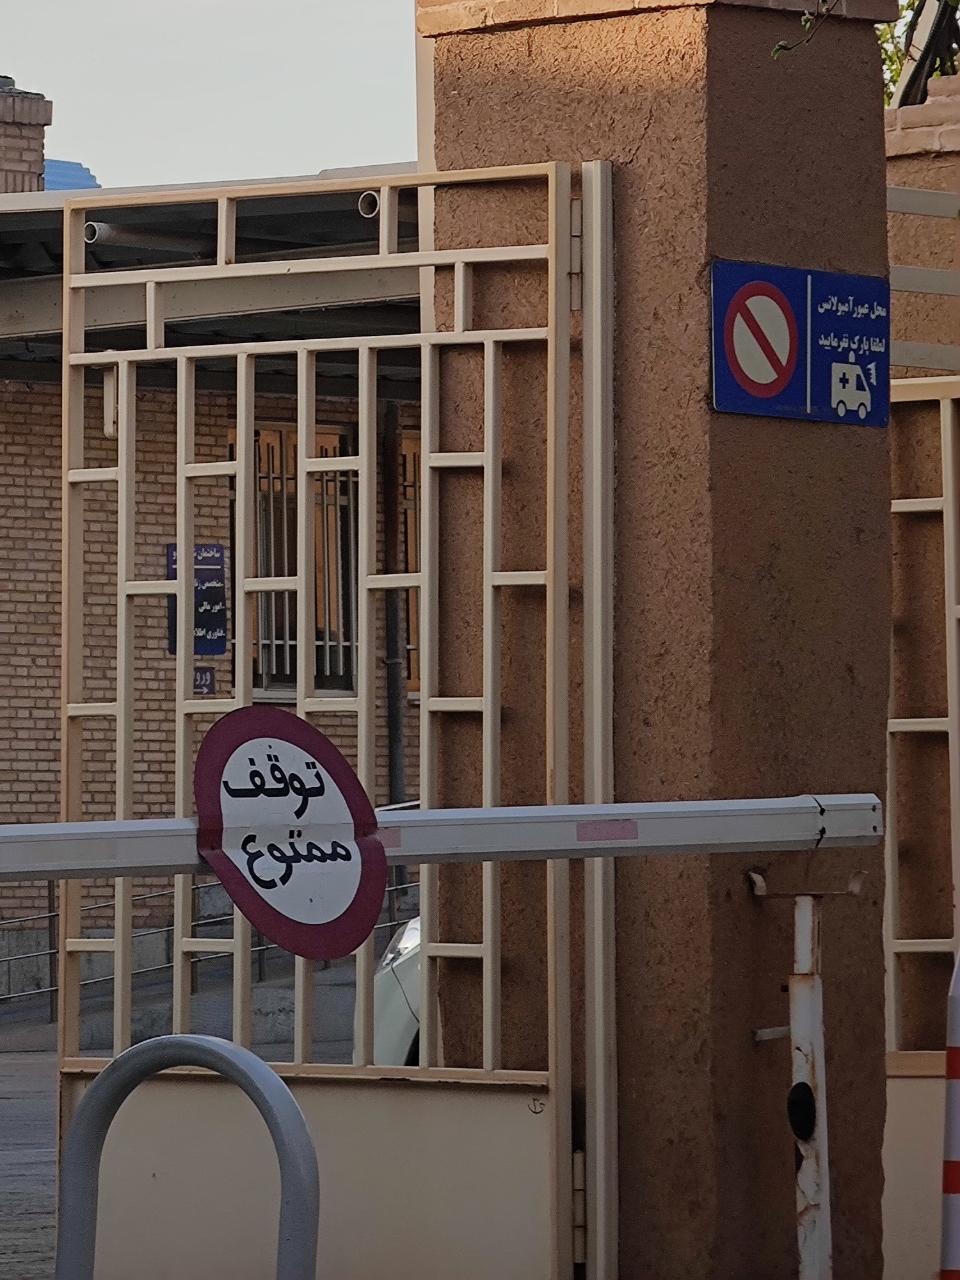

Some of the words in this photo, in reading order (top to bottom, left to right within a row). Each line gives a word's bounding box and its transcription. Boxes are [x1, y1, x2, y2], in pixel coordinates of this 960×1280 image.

[817, 295, 855, 316] آمبولانس
[852, 303, 870, 319] عبور
[870, 301, 887, 320] محل
[850, 335, 870, 356] پارک
[195, 671, 212, 685] ورو
[222, 753, 326, 821] توقف
[240, 829, 353, 891] ممنوع
